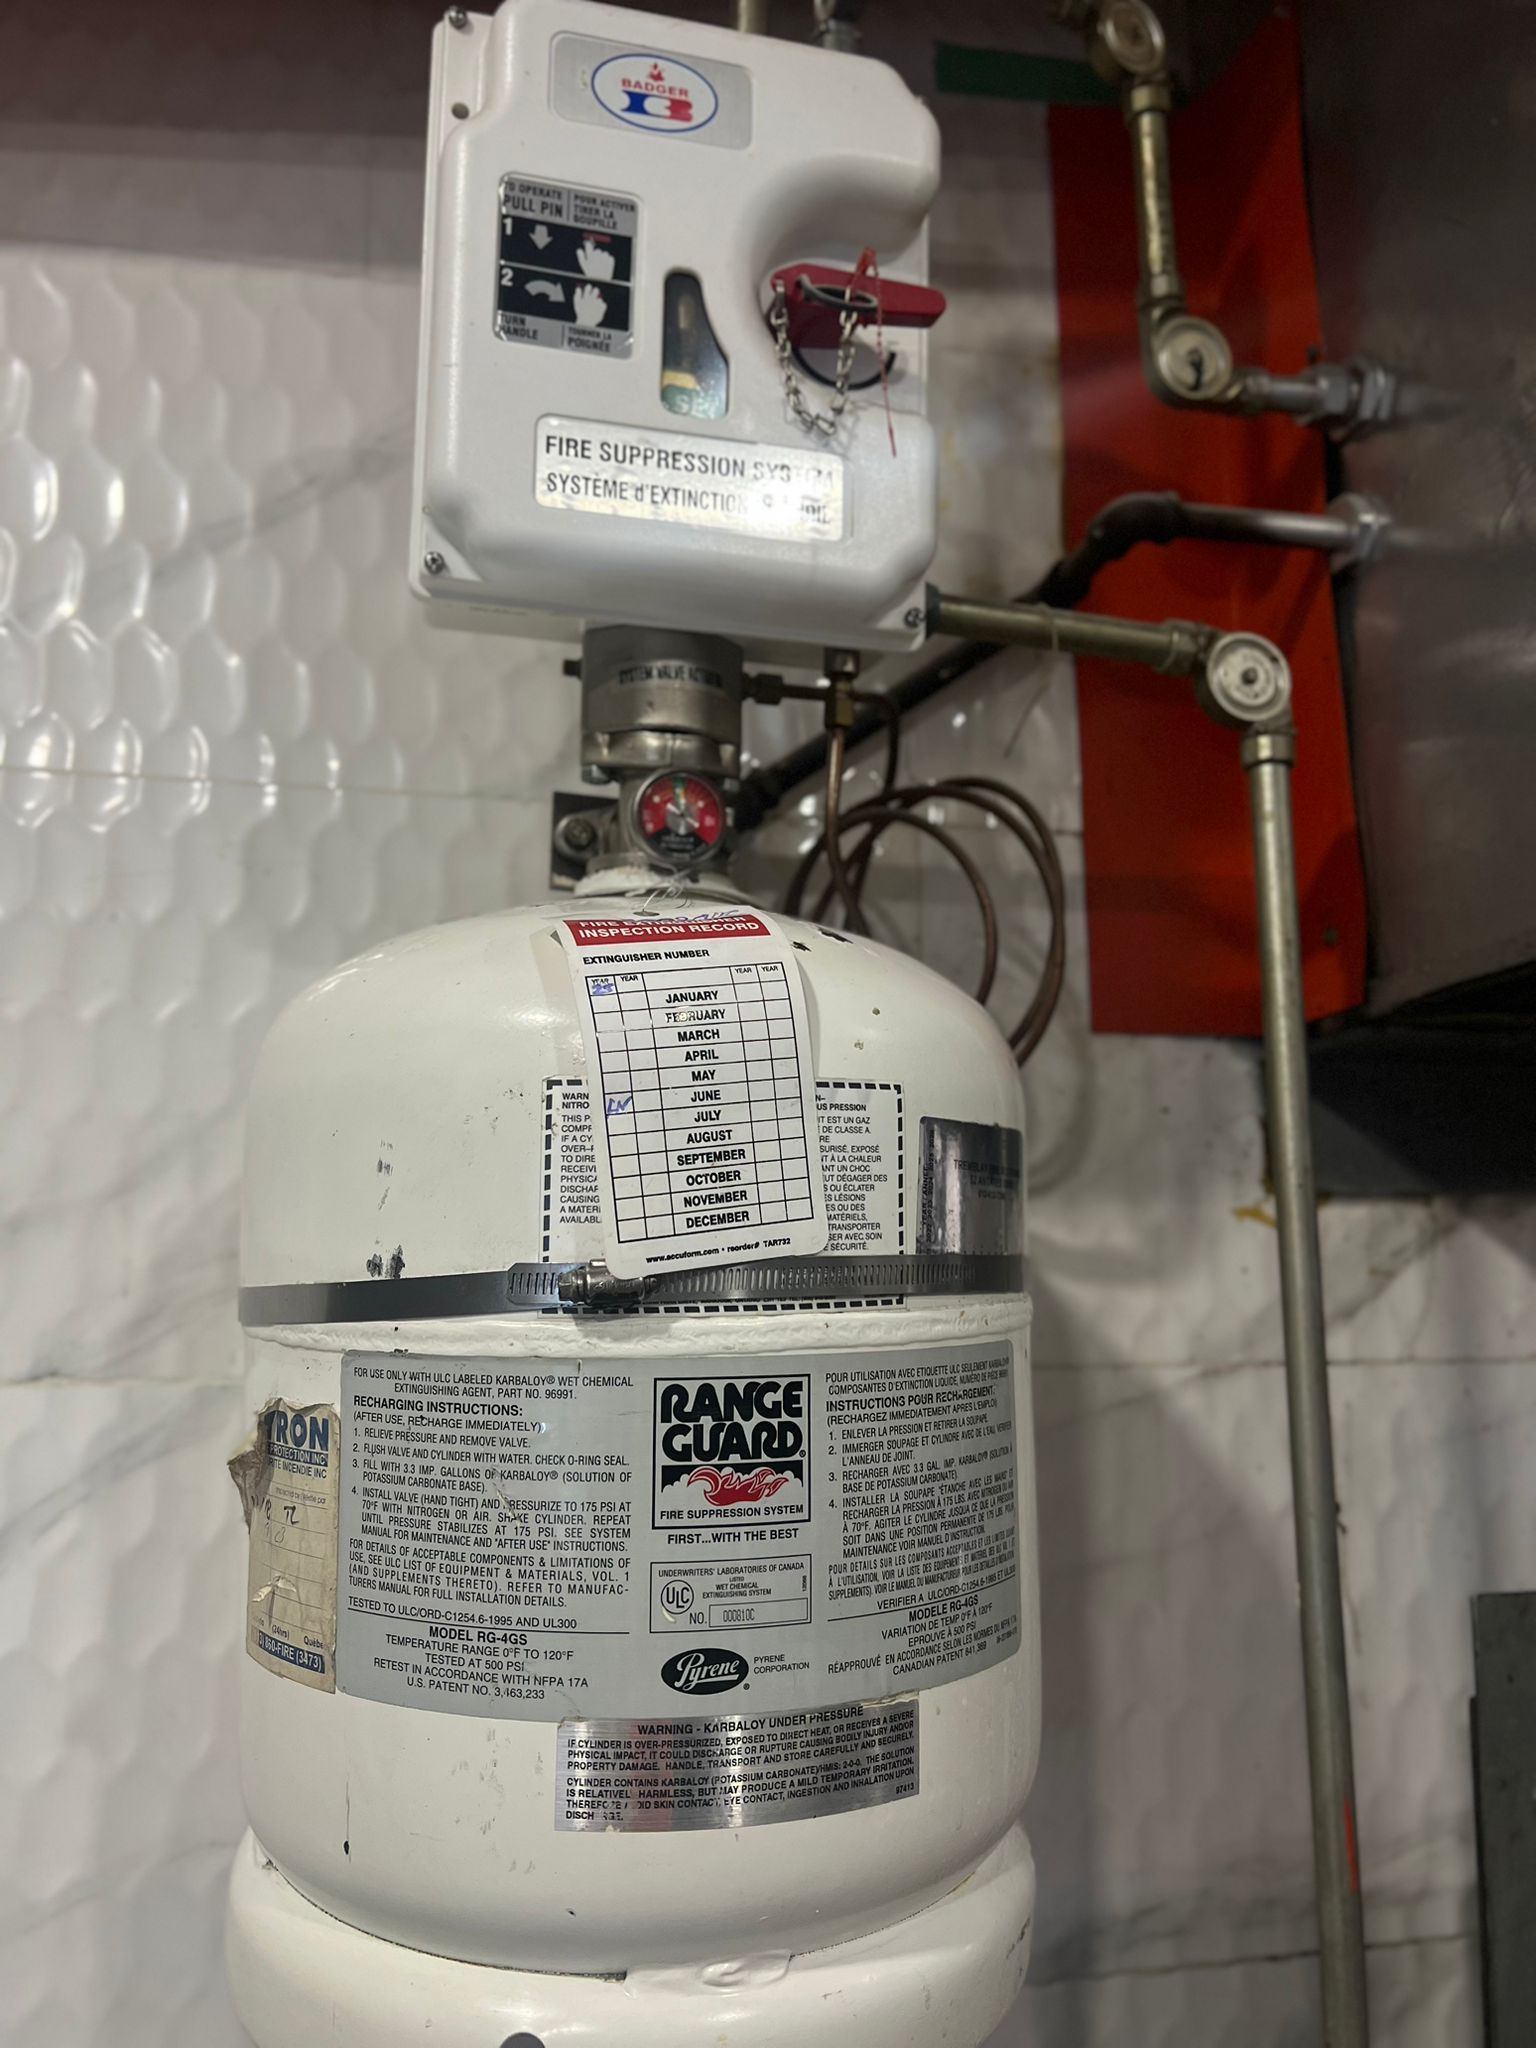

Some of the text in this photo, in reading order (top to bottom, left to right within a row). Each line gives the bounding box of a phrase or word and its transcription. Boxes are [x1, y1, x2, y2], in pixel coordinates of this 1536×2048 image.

[621, 78, 689, 97] BADGER
[519, 185, 562, 200] OPERATE
[541, 202, 563, 217] PIN
[503, 218, 512, 235] 1
[501, 268, 513, 286] 2
[545, 436, 591, 459] FIRE
[599, 441, 744, 478] SUPPRESSION
[544, 470, 632, 501] SYSTÈME
[578, 919, 761, 937] INSPECTION RECORD
[582, 949, 709, 964] EXTINGUISHER NUMBER
[619, 973, 638, 982] YEAR
[734, 965, 752, 974] YEAR
[760, 963, 778, 972] YEAR
[665, 990, 718, 1007] JANUARY
[664, 1008, 725, 1026] FEBRUARY
[677, 1028, 720, 1042] MARCH
[684, 1048, 719, 1065] APRIL
[691, 1069, 715, 1081] MAY
[690, 1089, 721, 1102] JUNE
[694, 1109, 721, 1122] JULY
[828, 1103, 866, 1111] PRESSION
[561, 1114, 582, 1122] THIS
[854, 1116, 870, 1124] GAZ
[686, 1129, 732, 1144] AUGUST
[821, 1125, 832, 1133] DE
[834, 1125, 863, 1134] CLASSE
[850, 1144, 879, 1153] EXPOSÉ
[676, 1148, 746, 1168] SEPTEMBER
[685, 1170, 741, 1186] OCTOBER
[836, 1173, 887, 1182] DÉGAGER DES
[559, 1195, 600, 1203] CAUSING
[683, 1190, 747, 1207] NOVEMBER
[833, 1193, 866, 1201] LÉSIONS
[685, 1210, 749, 1230] DECEMBER
[645, 1237, 790, 1262] www.accuform.com reorder# TAR732
[353, 1366, 368, 1377] FOR
[369, 1368, 384, 1378] USE
[385, 1369, 407, 1380] ONLY
[408, 1371, 431, 1381] WITH
[433, 1372, 450, 1383] ULC
[452, 1373, 492, 1384] LABELED
[557, 1376, 580, 1386] WET
[581, 1376, 633, 1386] CHEMICAL
[394, 1382, 576, 1399] EXTINGUISHING AGENT, PART NO. 96991.
[353, 1395, 522, 1415] RECHARGING INSTRUCTIONS:
[660, 1381, 803, 1423] RANGE
[825, 1392, 933, 1412] INSTRUCTIONS POUR
[662, 1421, 803, 1462] GUARD
[660, 1504, 803, 1519] FIRE SUPPRESSION SYSTEM
[743, 1530, 766, 1541] THE
[769, 1527, 799, 1539] BEST
[716, 1564, 767, 1575] LABORATORIES
[768, 1563, 777, 1572] OF
[778, 1561, 804, 1571] CANADA
[702, 1588, 771, 1598] EXTINGUISHING SYSTEM
[729, 1582, 758, 1590] CHEMICAL
[666, 1587, 690, 1608] ULC
[349, 1596, 381, 1613] TESTED
[382, 1602, 396, 1613] TO
[515, 1616, 539, 1627] AND
[542, 1617, 577, 1628] UL300
[429, 1626, 527, 1645] MODEL RG-4GS
[296, 1650, 322, 1671] (3473)
[424, 1652, 524, 1671] TESTED AT 500 PSI
[753, 1654, 785, 1664] PYRENE
[753, 1661, 809, 1674] CORPORATION
[373, 1657, 588, 1687] RETEST IN ACCORDANCE WITH NFPA 17A
[675, 1652, 740, 1691] Pyrene
[637, 1705, 866, 1735] WARNING KARBALOY UNDER PRESSURE
[567, 1732, 913, 1771] PROPERTY DAMAGE. HANDLE, TRANSPORT AND STORE CAREFULLY AND SECURELY.
